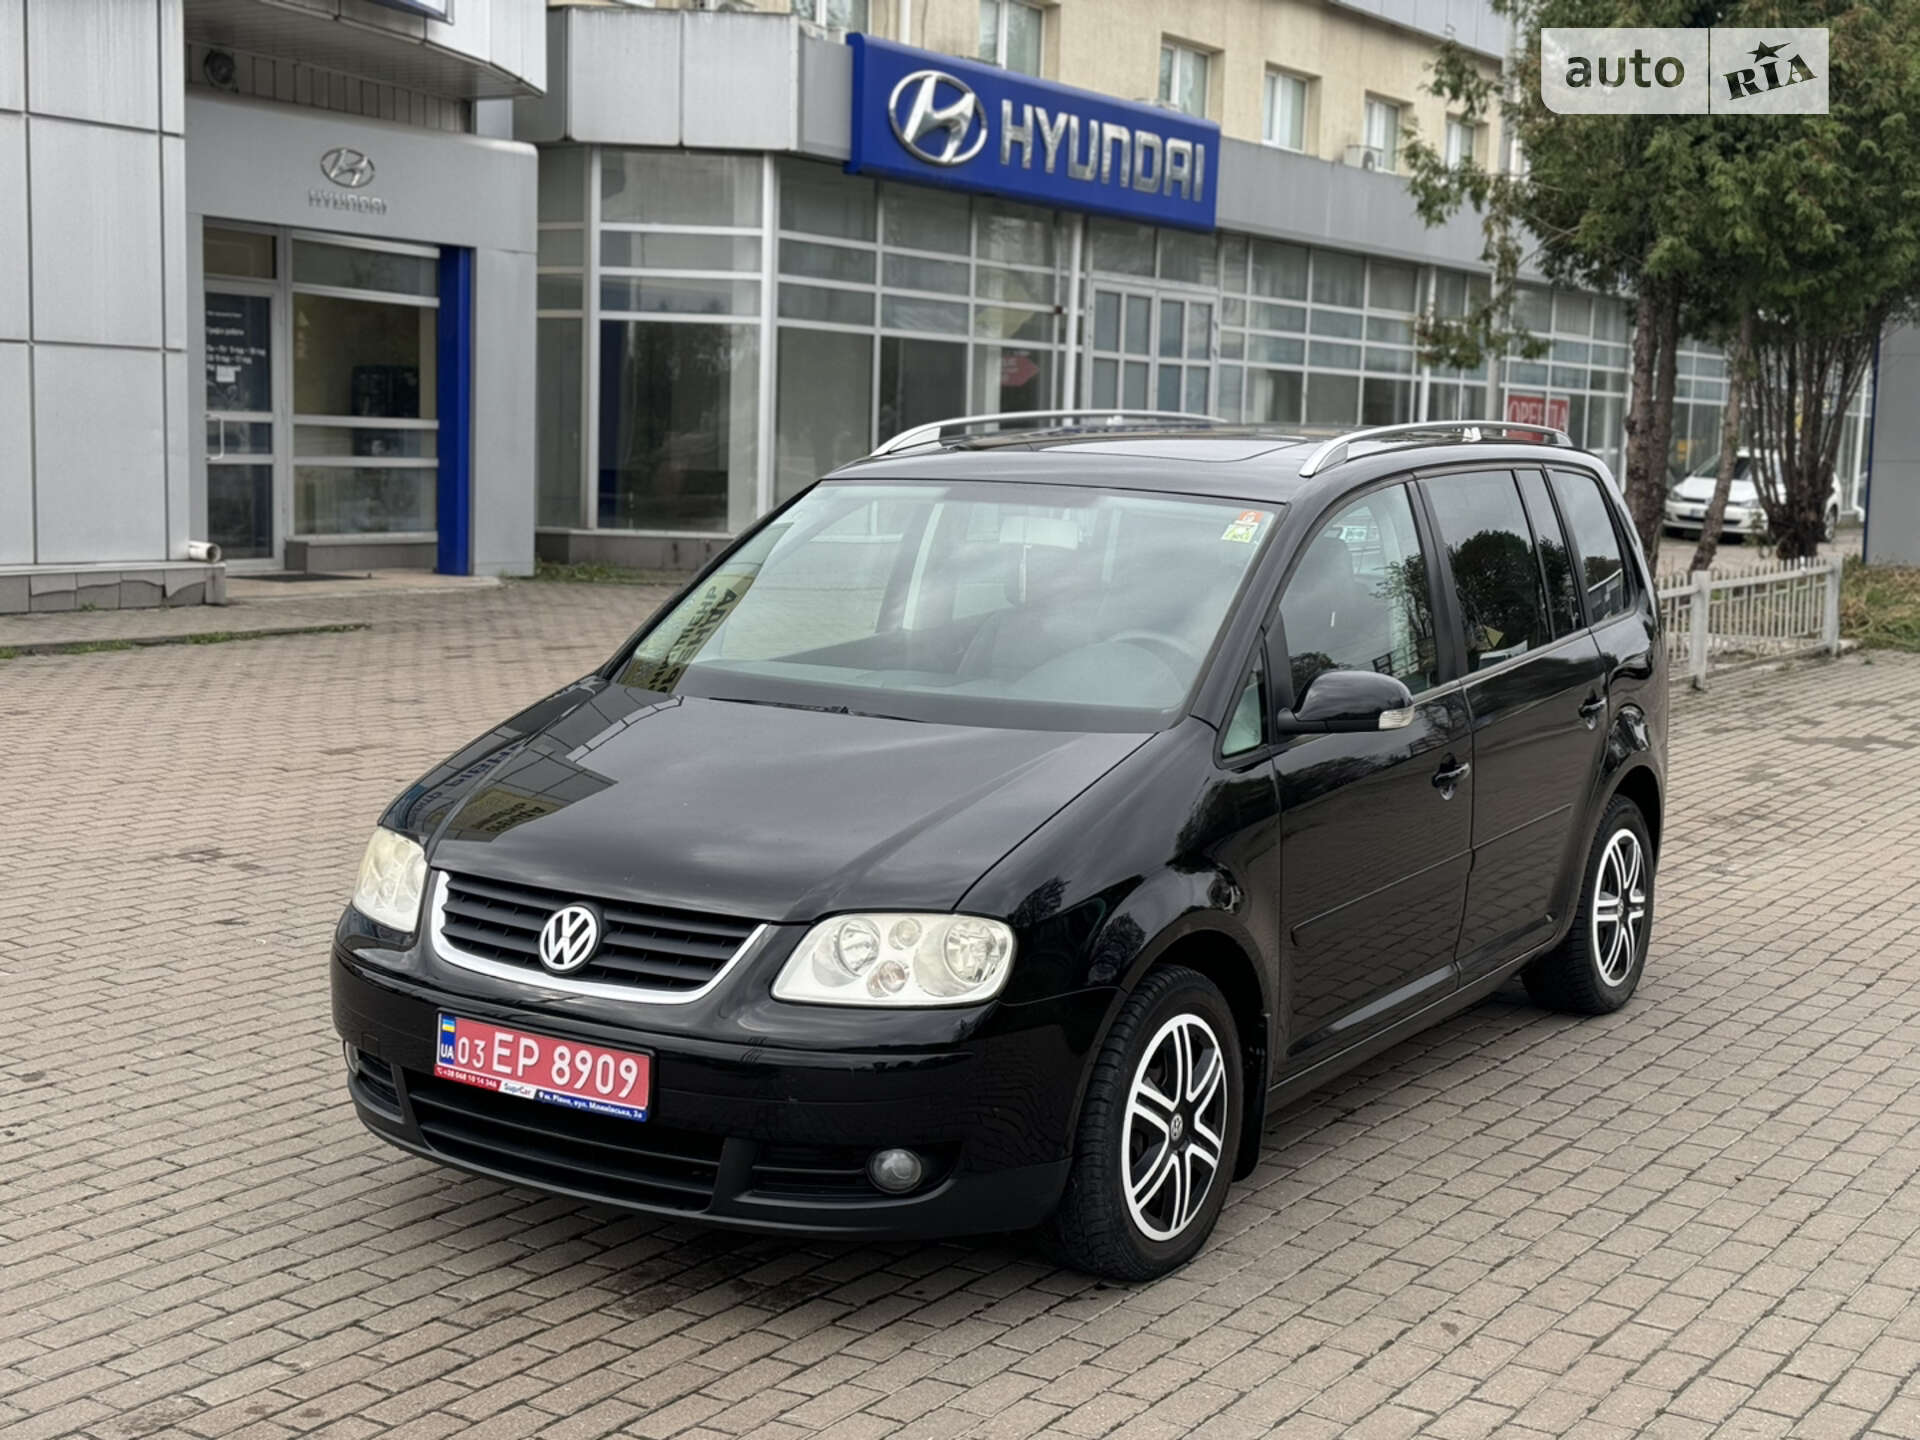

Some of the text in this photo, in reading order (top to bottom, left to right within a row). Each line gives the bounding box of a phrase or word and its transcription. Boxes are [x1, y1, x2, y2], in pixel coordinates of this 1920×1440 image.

[1001, 99, 1205, 202] HYUNDAI
[440, 1043, 455, 1060] UA
[457, 1031, 638, 1098] 03 EP 8909
